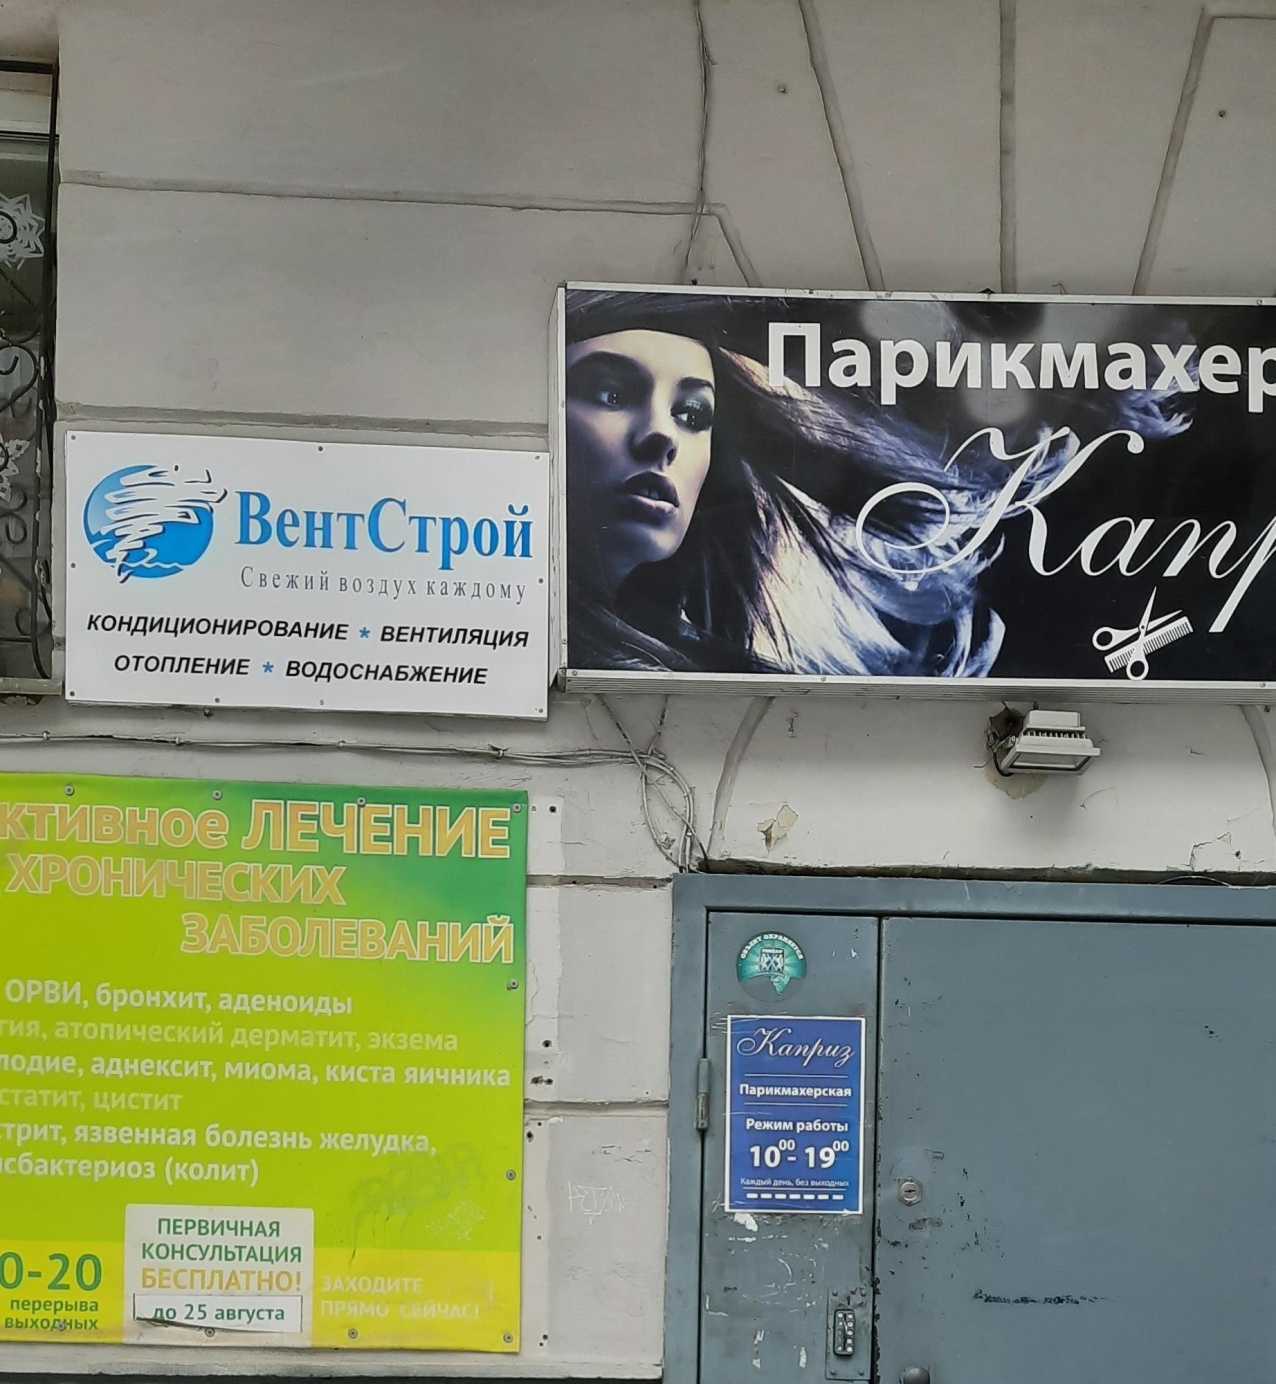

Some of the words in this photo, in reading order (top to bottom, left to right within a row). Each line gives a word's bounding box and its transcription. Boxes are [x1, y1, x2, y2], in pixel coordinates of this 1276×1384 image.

[235, 490, 533, 570] ВентСтрой
[240, 566, 330, 592] Свежий
[338, 574, 417, 597] воздух
[427, 577, 527, 604] каждому
[88, 614, 349, 641] КОНДИЦИОНИРОВАНИЕ
[380, 625, 530, 650] ВЕНТИЛЯЦИЯ
[114, 654, 249, 676] ОТОПЛЕНИЕ
[285, 661, 488, 685] ВОДОСНАБЖЕНИЕ
[241, 799, 511, 858] ЛЕЧЕНИЕ
[6, 853, 347, 905] ХРОНИЧЕСКИХ
[180, 913, 514, 964] ЗАБОЛЕВАНИЙ
[5, 979, 88, 1009] ОРВИ,
[95, 982, 211, 1014] бронхит,
[218, 990, 353, 1016] аденоиды
[55, 1019, 224, 1047] атопический
[231, 1027, 362, 1053] дерматит,
[368, 1030, 459, 1052] экзема
[737, 1027, 855, 1068] Каприз
[91, 1055, 218, 1081] аднексит,
[224, 1062, 318, 1085] миома,
[325, 1063, 396, 1085] киста
[403, 1067, 512, 1088] яичника
[93, 1090, 183, 1113] цистит
[739, 1083, 852, 1098] Парикмахерская
[0, 1122, 67, 1147] трит,
[74, 1123, 197, 1147] язвенная
[205, 1123, 312, 1150] болезнь
[319, 1130, 437, 1157] желудка,
[745, 1118, 794, 1132] Режим
[796, 1118, 848, 1134] работы
[0, 1152, 157, 1182] сбактериоз
[164, 1156, 259, 1187] (колит)
[157, 1217, 281, 1238] ПЕРВИЧНАЯ
[141, 1241, 302, 1265] КОНСУЛЬТАЦИЯ
[0, 1251, 102, 1291] 0-20
[141, 1269, 301, 1292] БЕСПЛАТНО!
[322, 1275, 424, 1296] ЗАХОДИТЕ
[10, 1298, 98, 1314] перерыва
[152, 1304, 177, 1322] до
[183, 1303, 208, 1321] 25
[214, 1306, 285, 1323] августа
[321, 1299, 389, 1318] ПРЯМО
[4, 1317, 98, 1332] выходных
